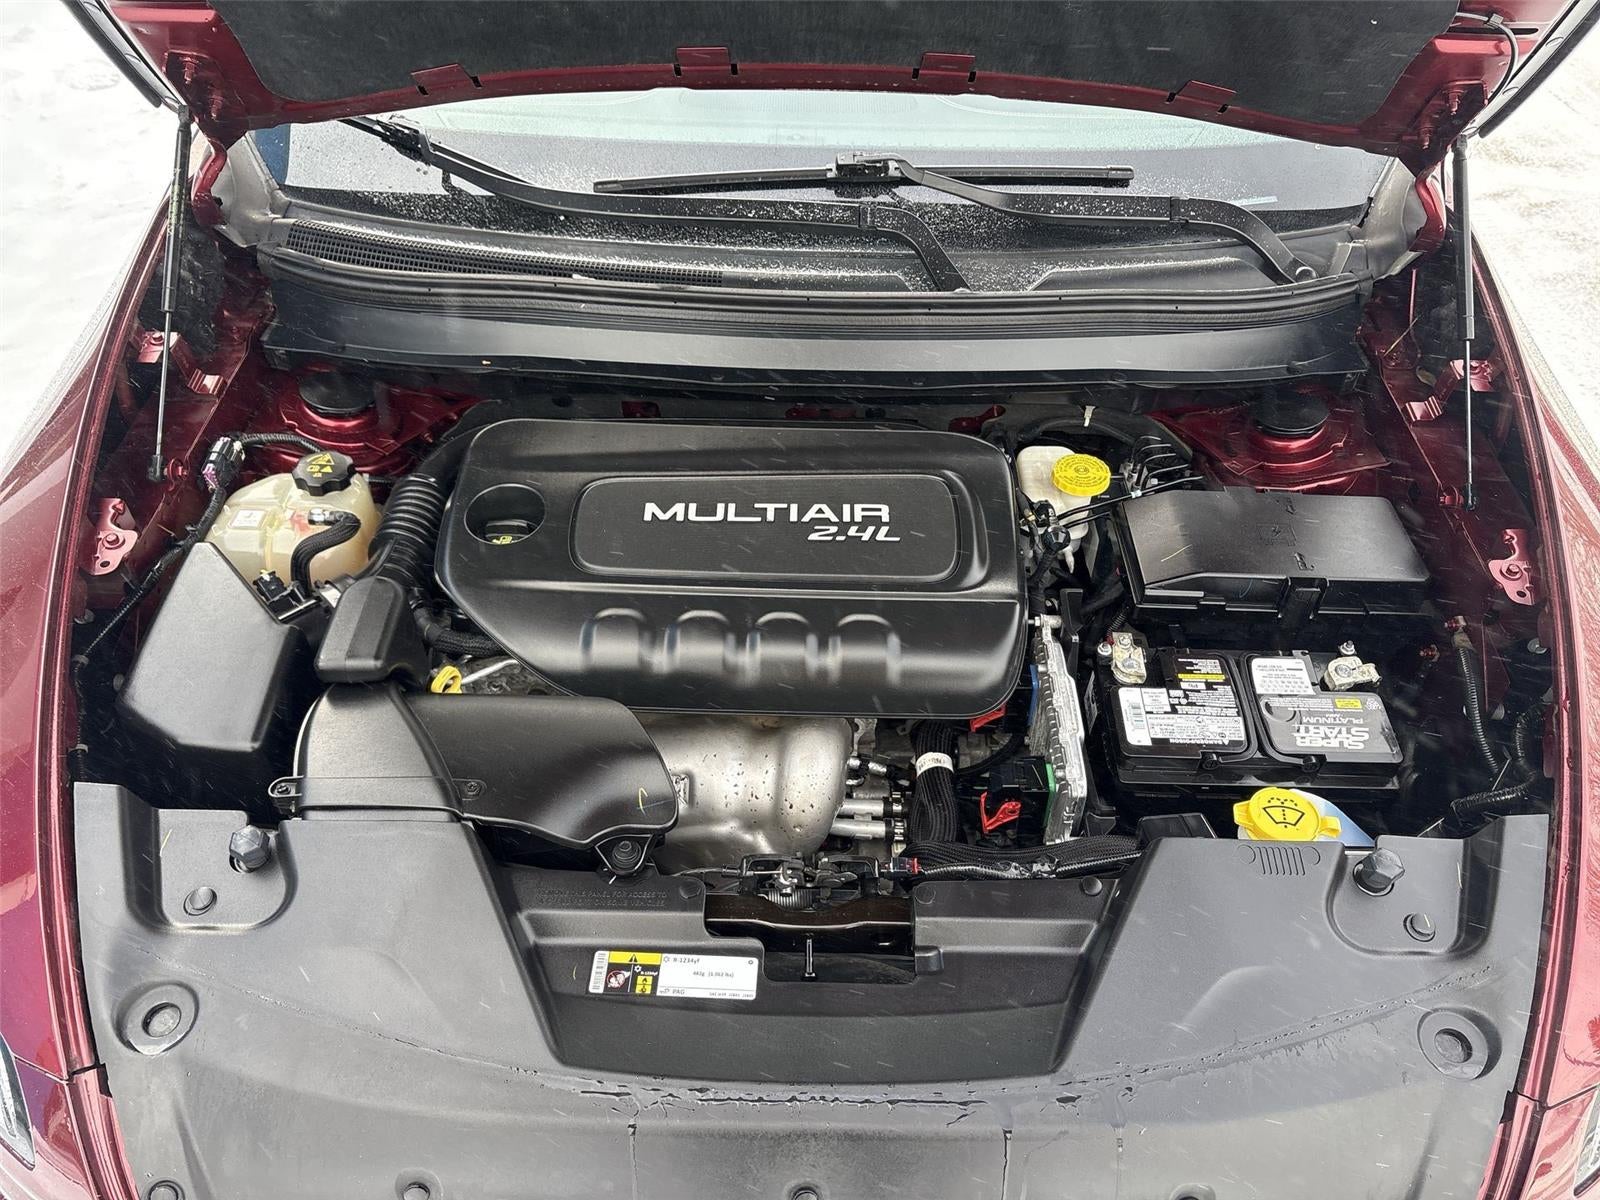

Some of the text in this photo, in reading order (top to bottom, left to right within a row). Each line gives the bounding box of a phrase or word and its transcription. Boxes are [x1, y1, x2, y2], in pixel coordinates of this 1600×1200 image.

[643, 502, 890, 522] MULTIAIR
[807, 525, 900, 542] 2.4L
[1303, 716, 1363, 724] PLATINUM
[1291, 724, 1369, 742] START
[1296, 736, 1364, 750] SUPER
[629, 891, 656, 899] ACCESS
[657, 891, 667, 899] TO
